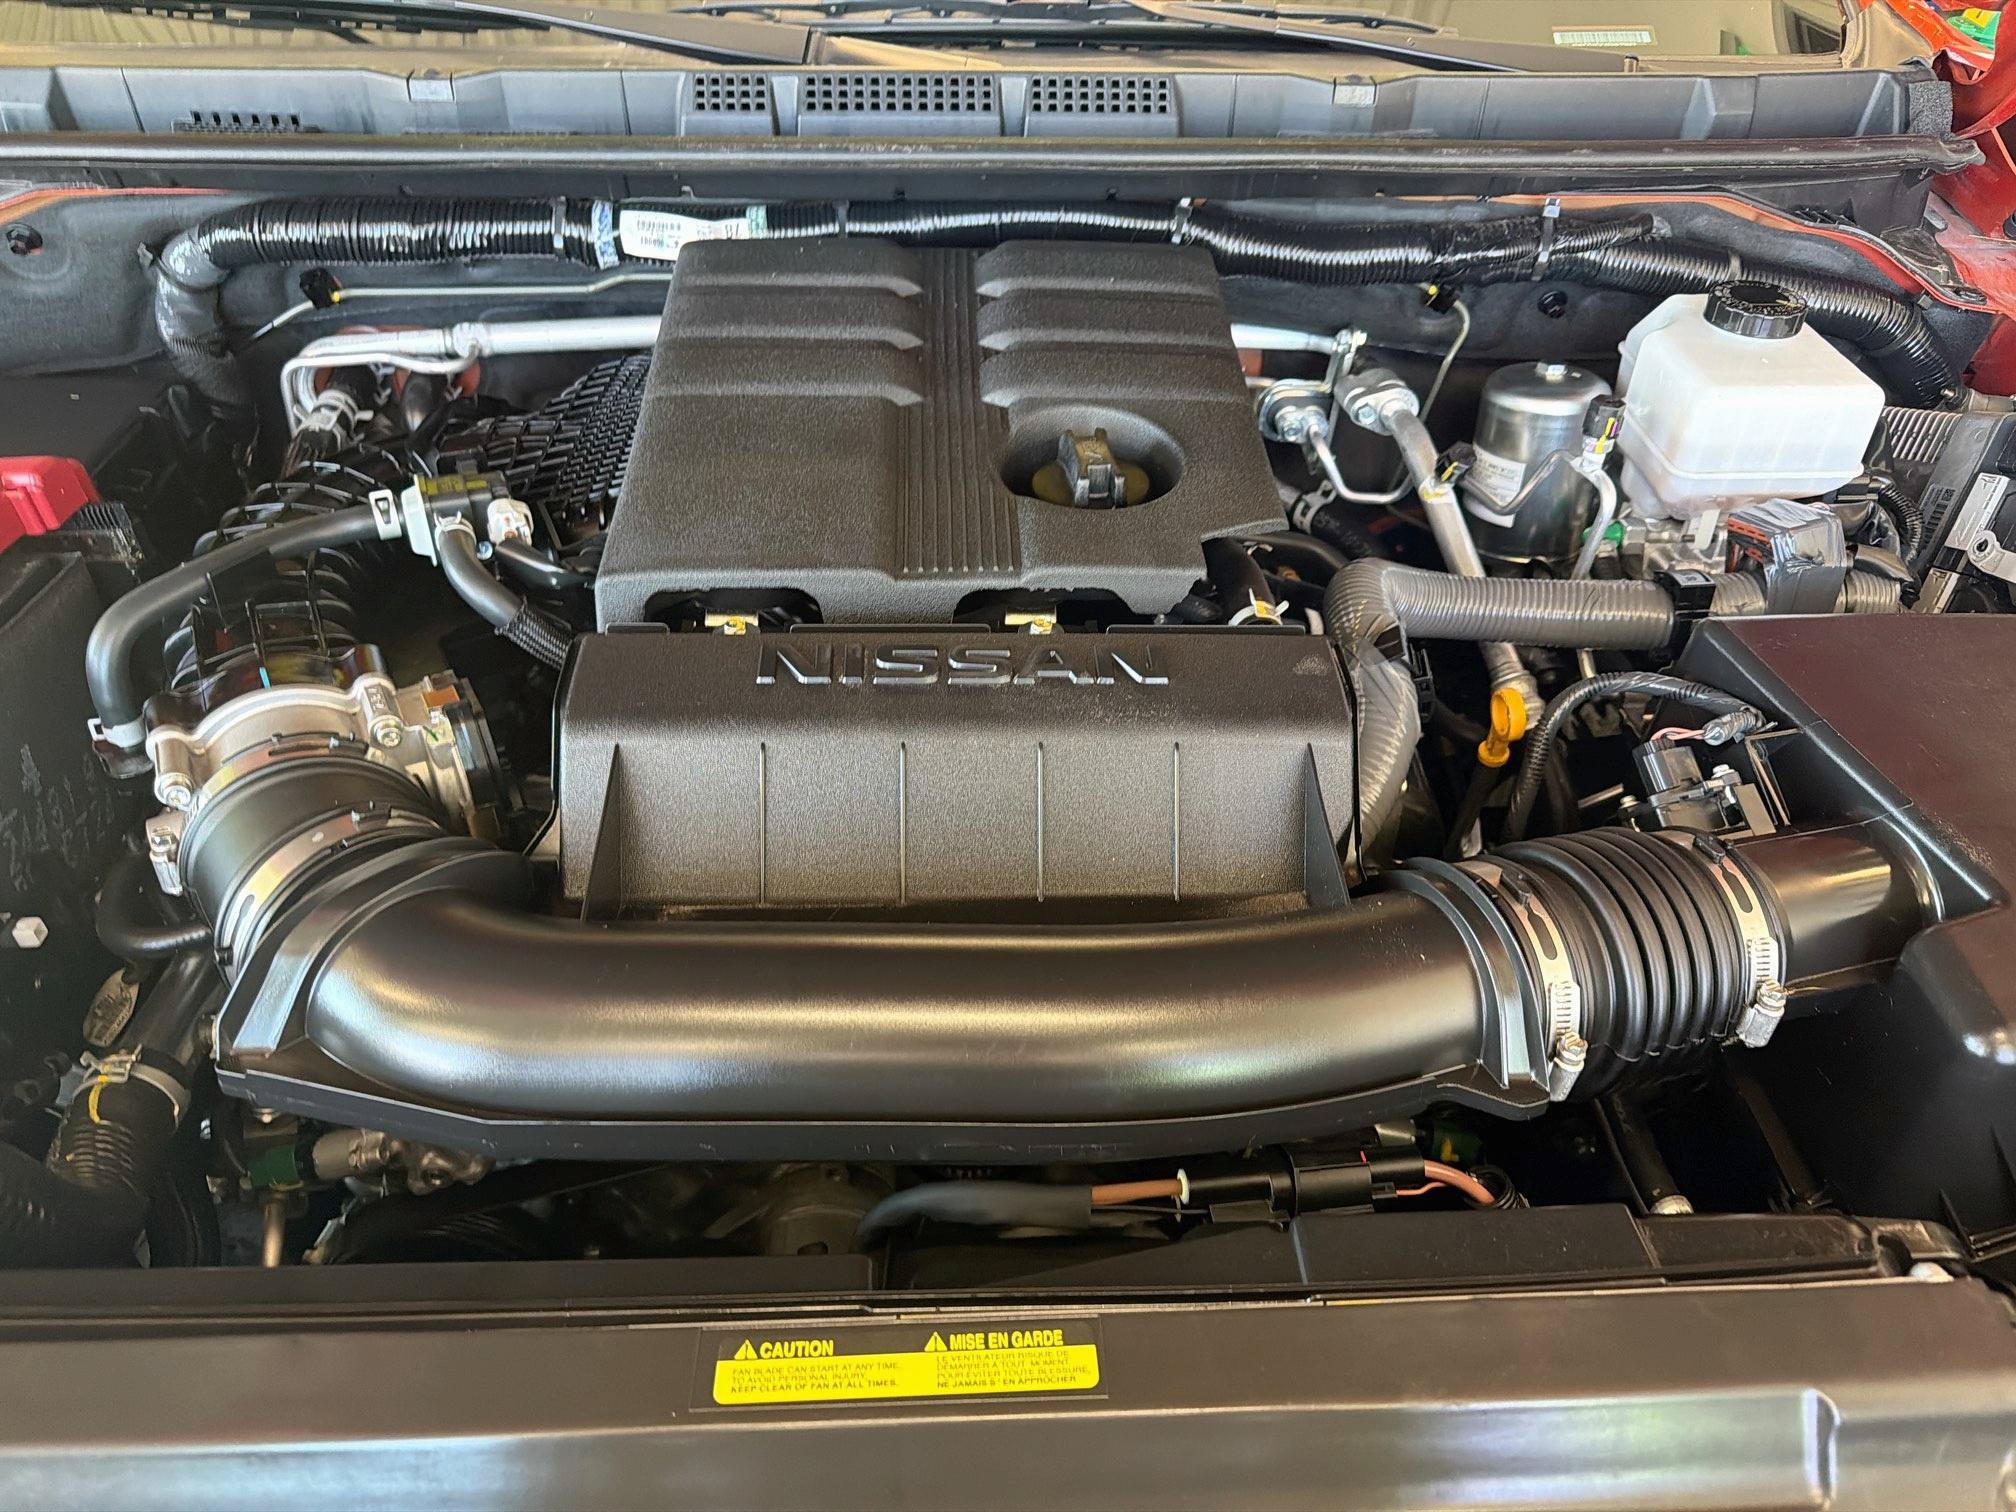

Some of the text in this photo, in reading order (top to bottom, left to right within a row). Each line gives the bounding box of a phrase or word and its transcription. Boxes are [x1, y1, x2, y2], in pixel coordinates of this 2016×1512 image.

[756, 643, 1170, 685] NISSAN
[949, 1329, 1064, 1350] MISE EN GARDE
[760, 1339, 834, 1358] CAUTION
[1057, 1350, 1069, 1358] DE
[856, 1363, 873, 1371] ANY
[731, 1386, 757, 1394] KEEP
[759, 1384, 792, 1392] CLEAR
[810, 1382, 830, 1390] FAN
[847, 1380, 864, 1388] ALL
